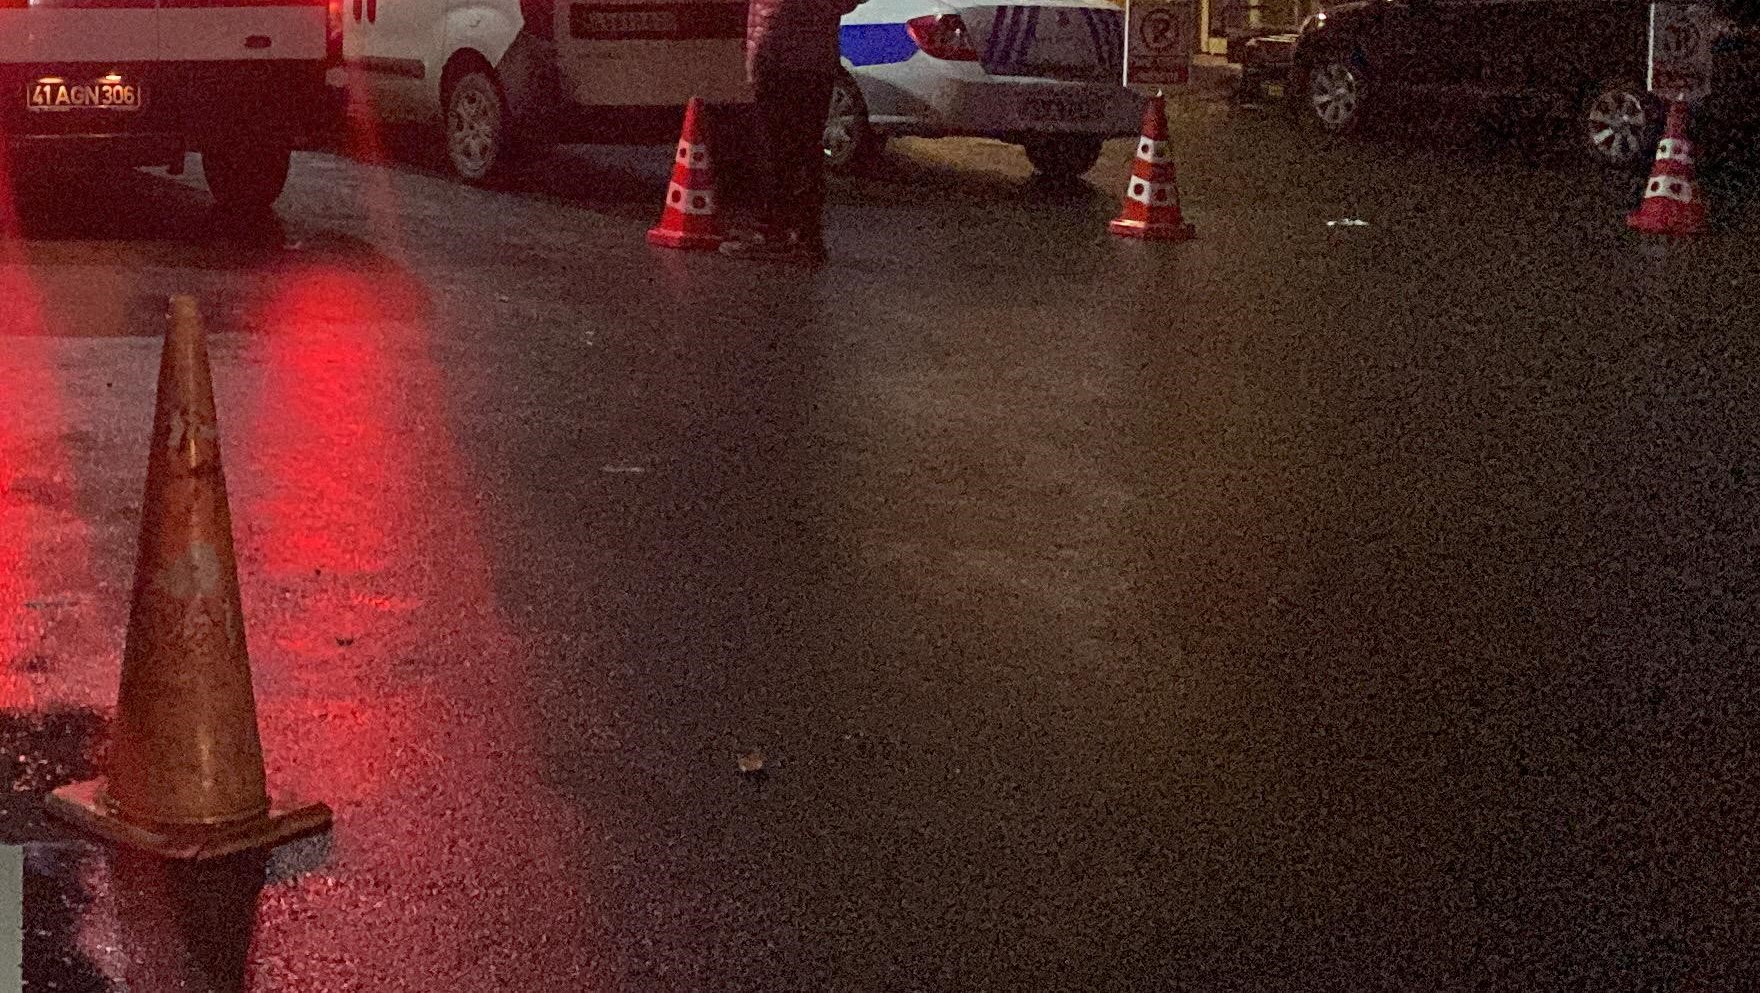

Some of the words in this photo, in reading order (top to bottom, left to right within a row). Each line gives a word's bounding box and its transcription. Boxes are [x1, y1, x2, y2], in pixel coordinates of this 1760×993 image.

[31, 84, 52, 106] 41
[55, 84, 100, 106] AGN
[101, 84, 136, 106] 306
